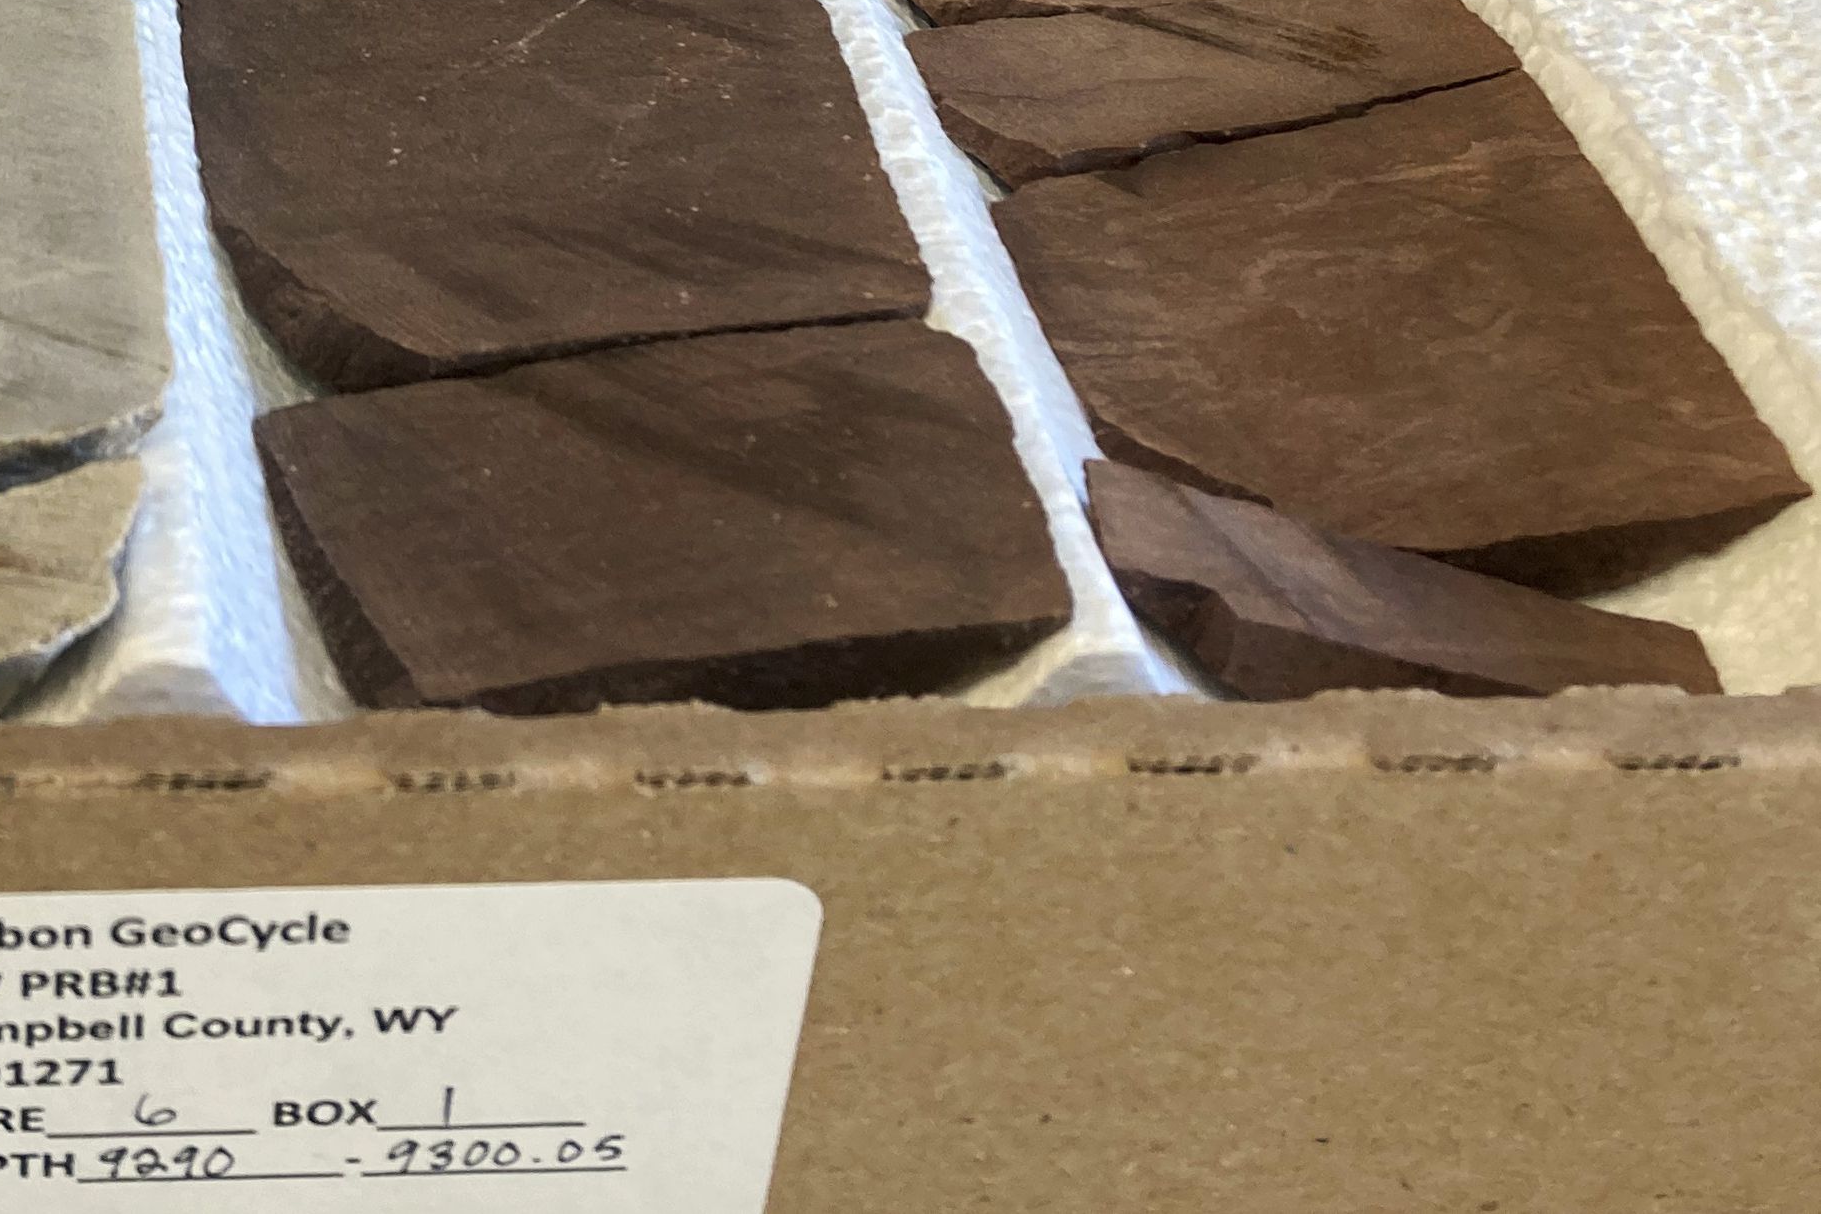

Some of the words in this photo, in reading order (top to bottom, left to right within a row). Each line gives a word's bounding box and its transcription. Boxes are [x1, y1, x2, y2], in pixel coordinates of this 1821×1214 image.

[109, 910, 352, 953] GeoCycle
[20, 968, 181, 1000] PRB#1
[163, 1010, 355, 1043] County,
[373, 1004, 459, 1034] WY
[133, 1091, 178, 1128] 6
[273, 1098, 379, 1128] BOX
[98, 1145, 237, 1181] 9290
[387, 1133, 626, 1174] 9300.05
